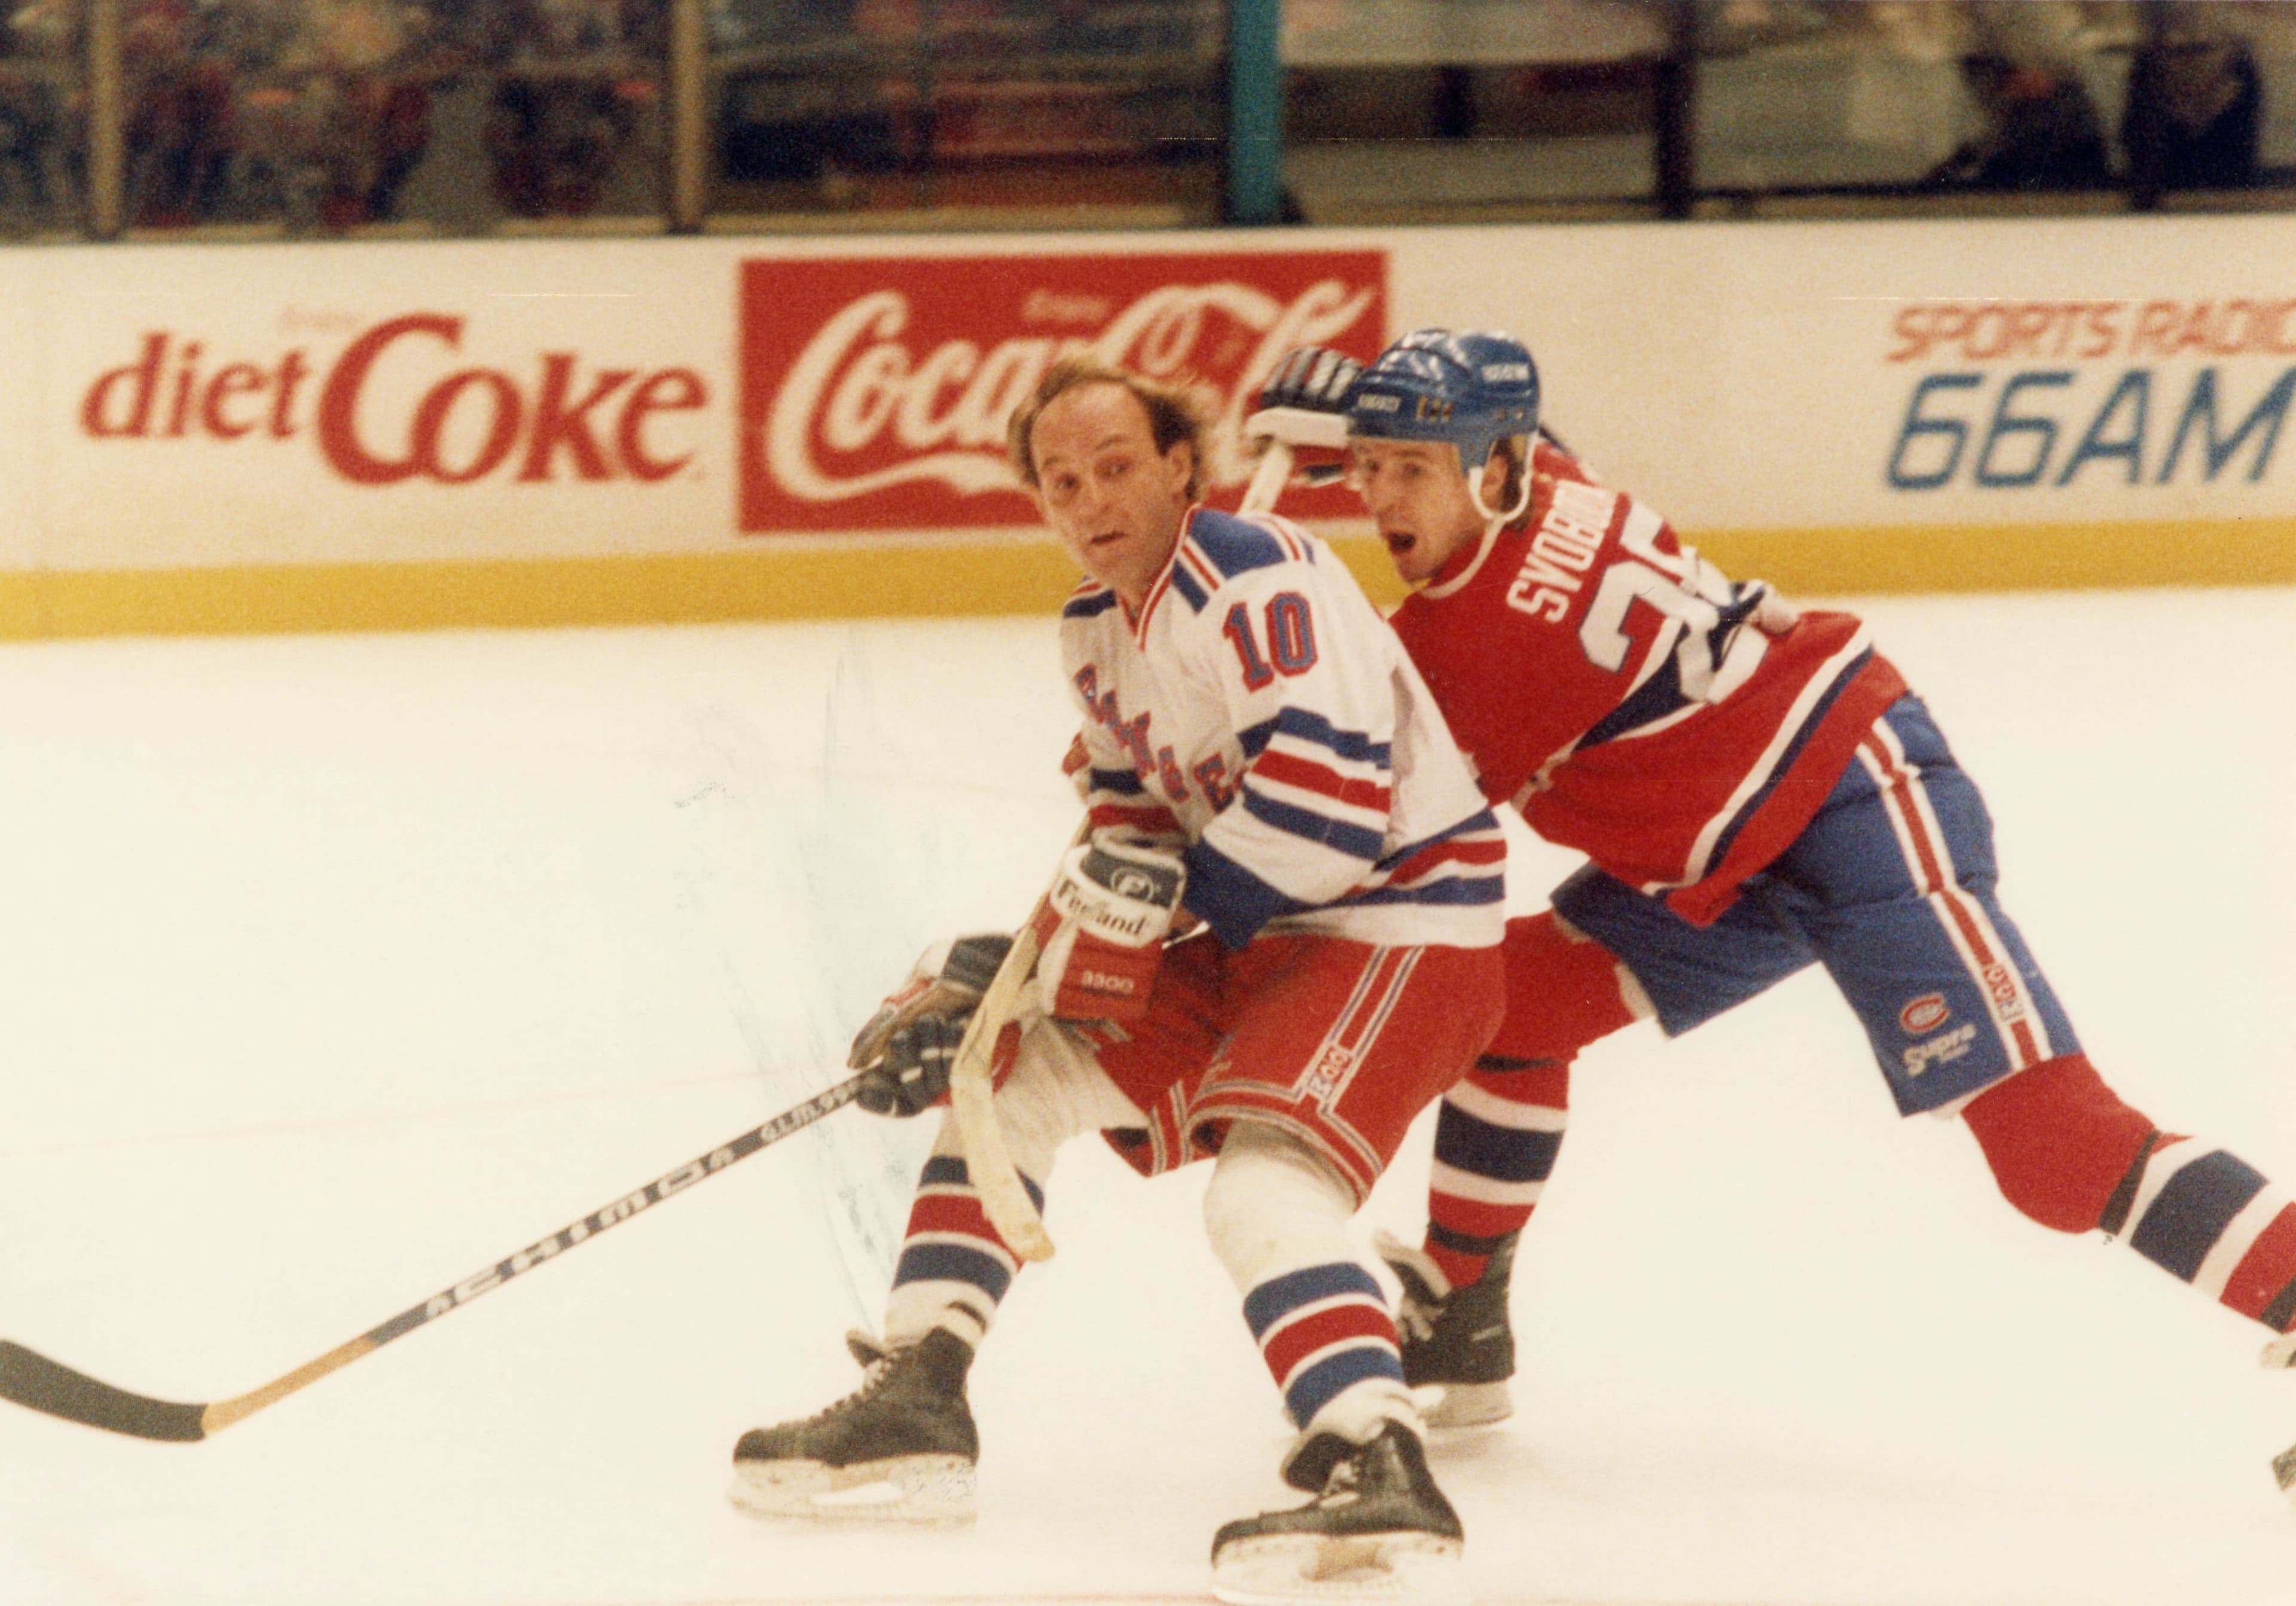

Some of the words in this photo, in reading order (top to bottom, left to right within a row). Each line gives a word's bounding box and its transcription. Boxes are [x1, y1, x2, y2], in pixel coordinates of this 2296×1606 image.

[1883, 299, 2127, 362] SPORTS
[80, 329, 315, 441] diet
[317, 311, 712, 488] Coke
[1222, 591, 1318, 693] 10
